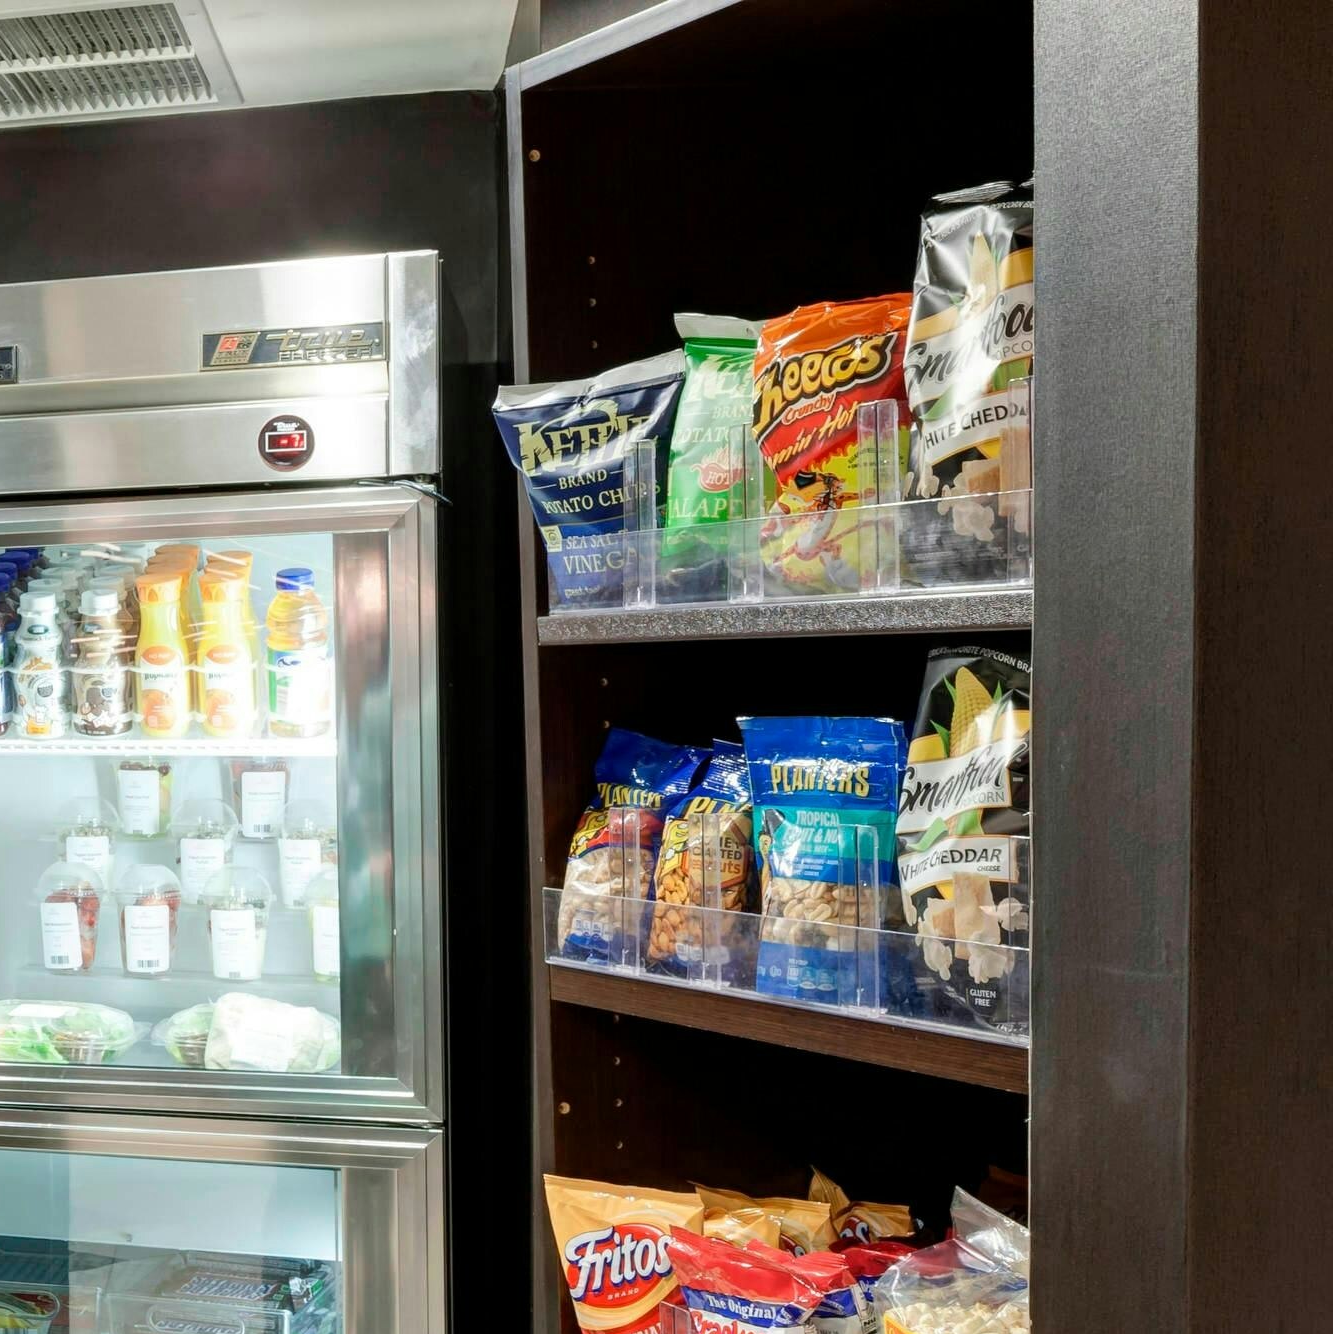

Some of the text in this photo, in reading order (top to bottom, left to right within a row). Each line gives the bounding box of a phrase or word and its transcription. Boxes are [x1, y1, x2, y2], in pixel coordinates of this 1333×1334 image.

[754, 332, 894, 434] heetos
[781, 391, 836, 425] Crunchy
[513, 399, 652, 477] KETTLE
[924, 422, 957, 450] HITE
[558, 469, 608, 490] BRAND
[542, 493, 594, 516] POTATO
[566, 535, 588, 550] SEA
[563, 547, 638, 575] VINEGA
[980, 646, 1016, 667] POPCORN
[771, 764, 870, 798] PLANTERS
[930, 847, 1002, 869] CHEDDAR
[976, 864, 1001, 873] CHEESE
[970, 988, 997, 999] GLUTEN
[974, 998, 991, 1007] FREE
[564, 1226, 677, 1301] Fritos
[607, 1287, 640, 1301] BRAND
[705, 1295, 776, 1320] The Original
